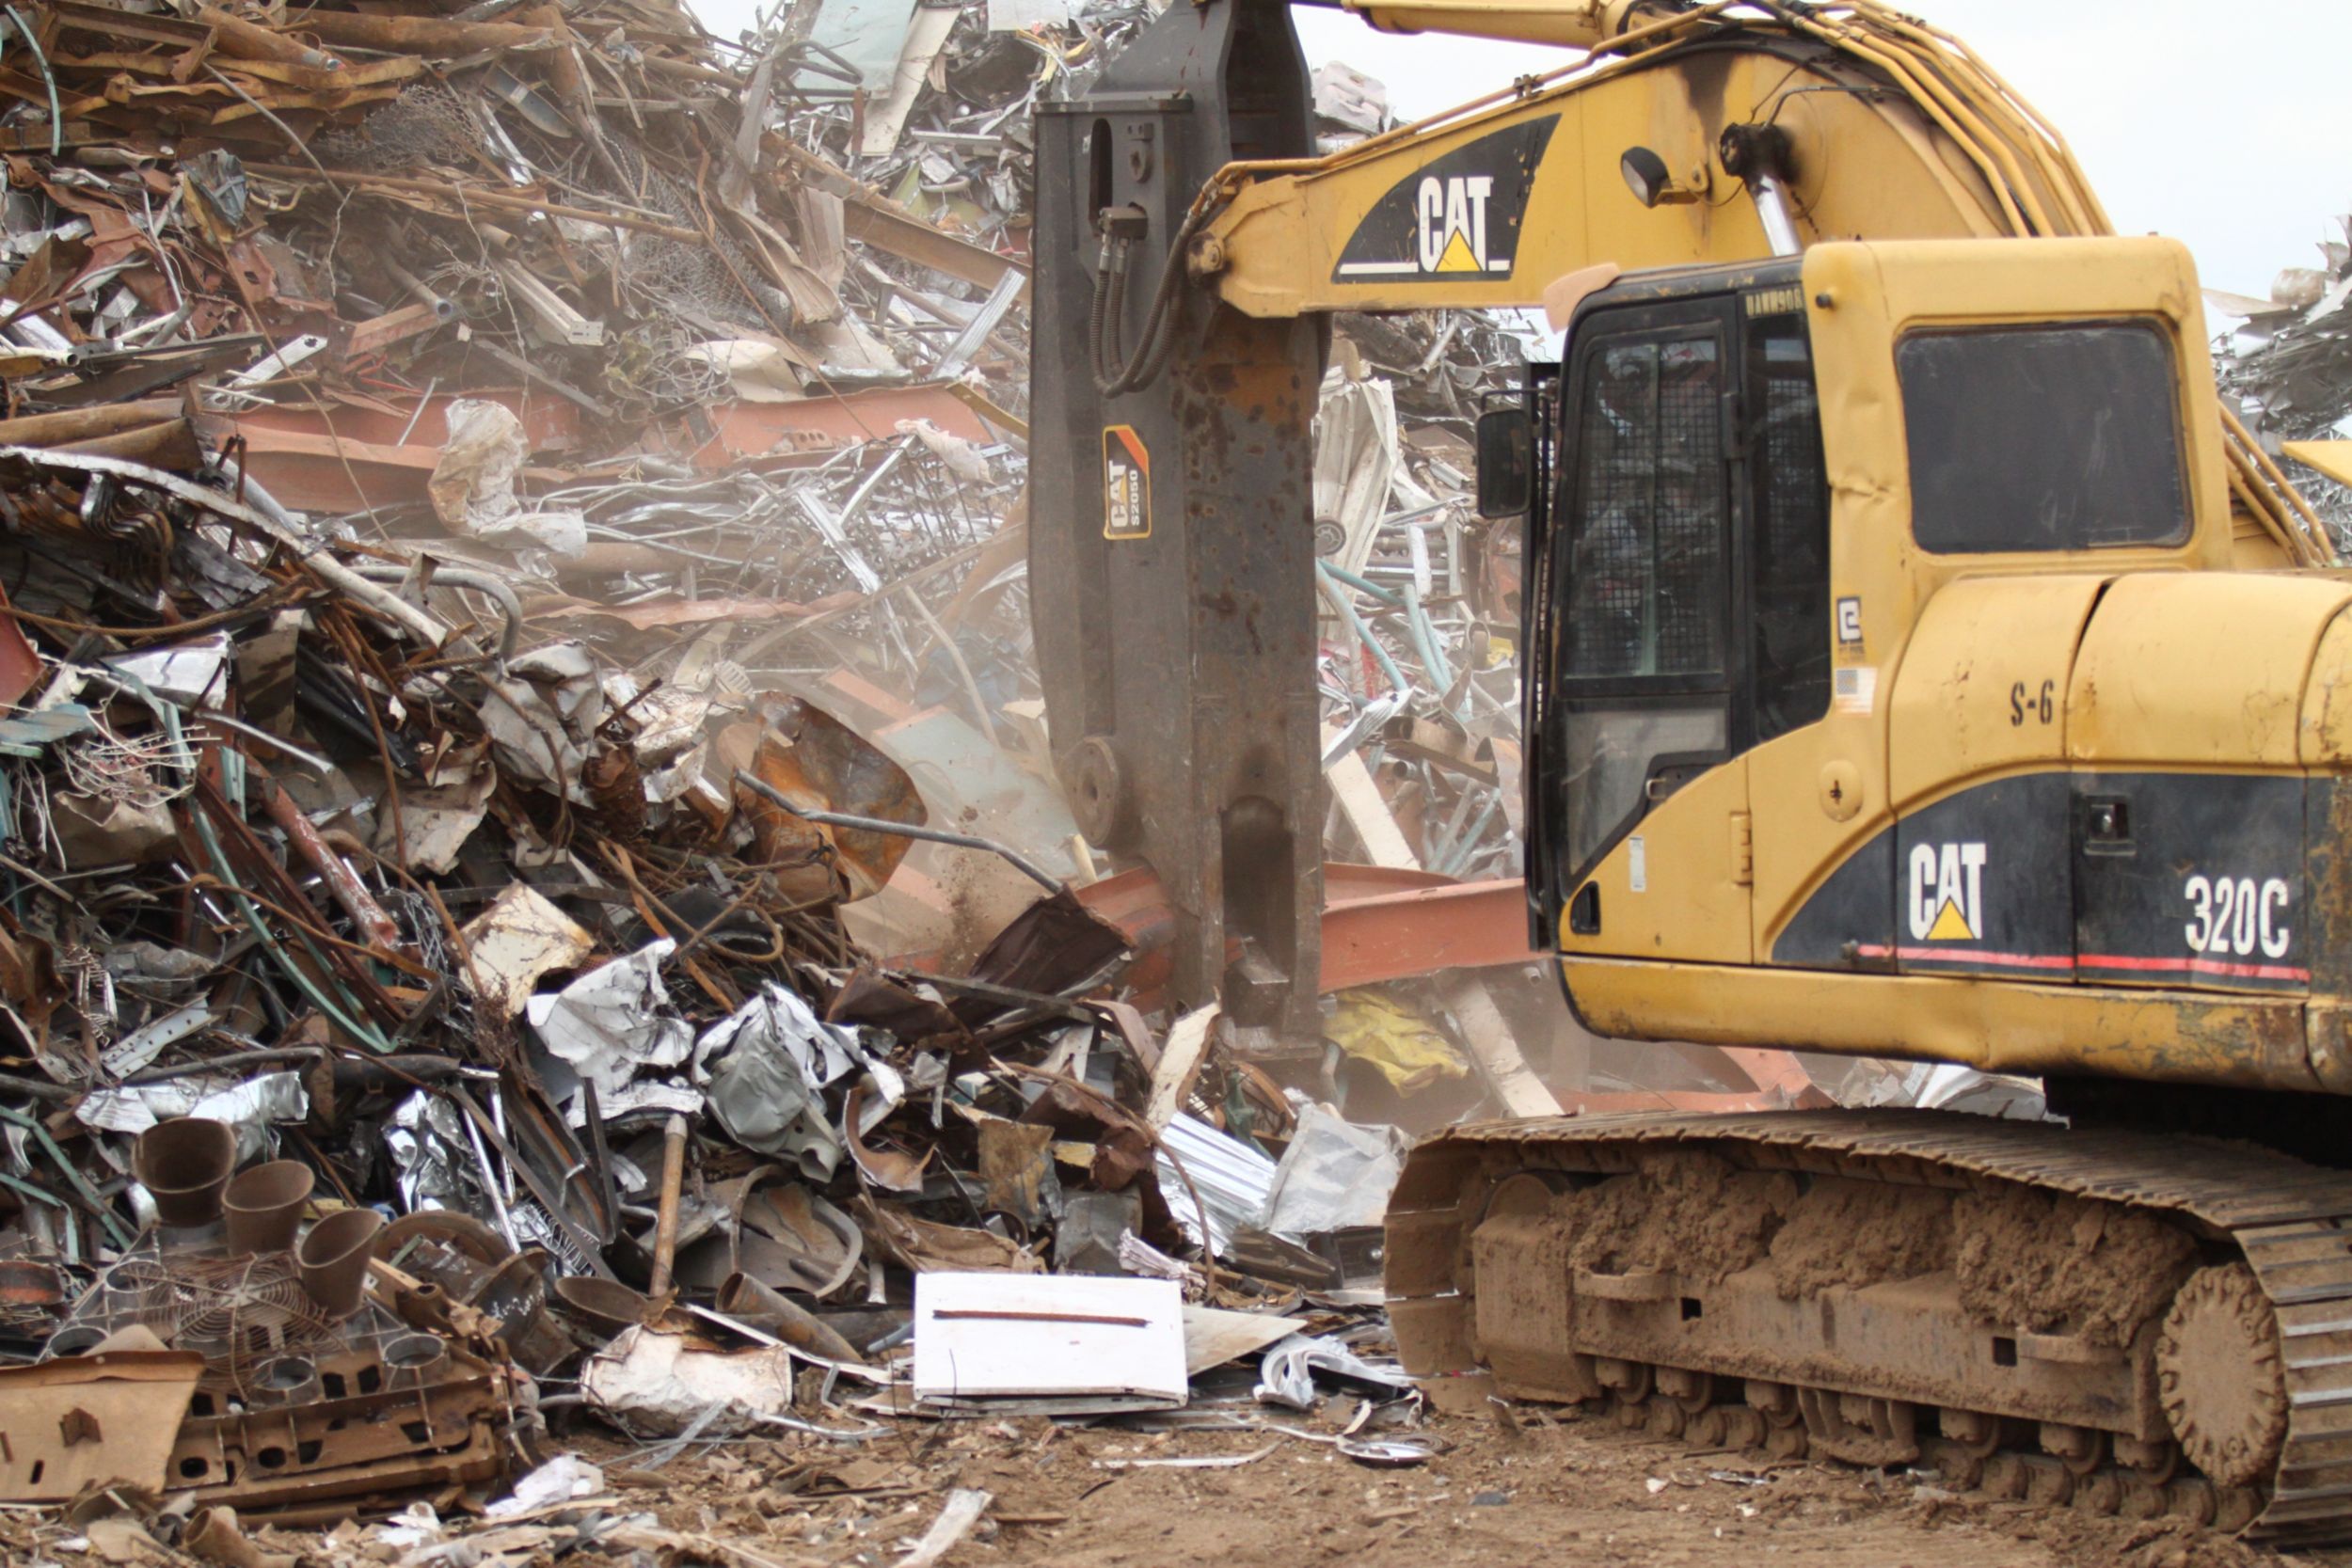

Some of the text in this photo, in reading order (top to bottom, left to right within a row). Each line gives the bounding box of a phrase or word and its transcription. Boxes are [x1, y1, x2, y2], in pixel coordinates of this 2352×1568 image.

[1419, 176, 1491, 272] CAT
[1108, 460, 1128, 527] CAT
[1130, 469, 1140, 527] S2050
[2010, 679, 2055, 727] S-6
[1909, 843, 1986, 941] CAT
[2185, 876, 2290, 958] 320C
